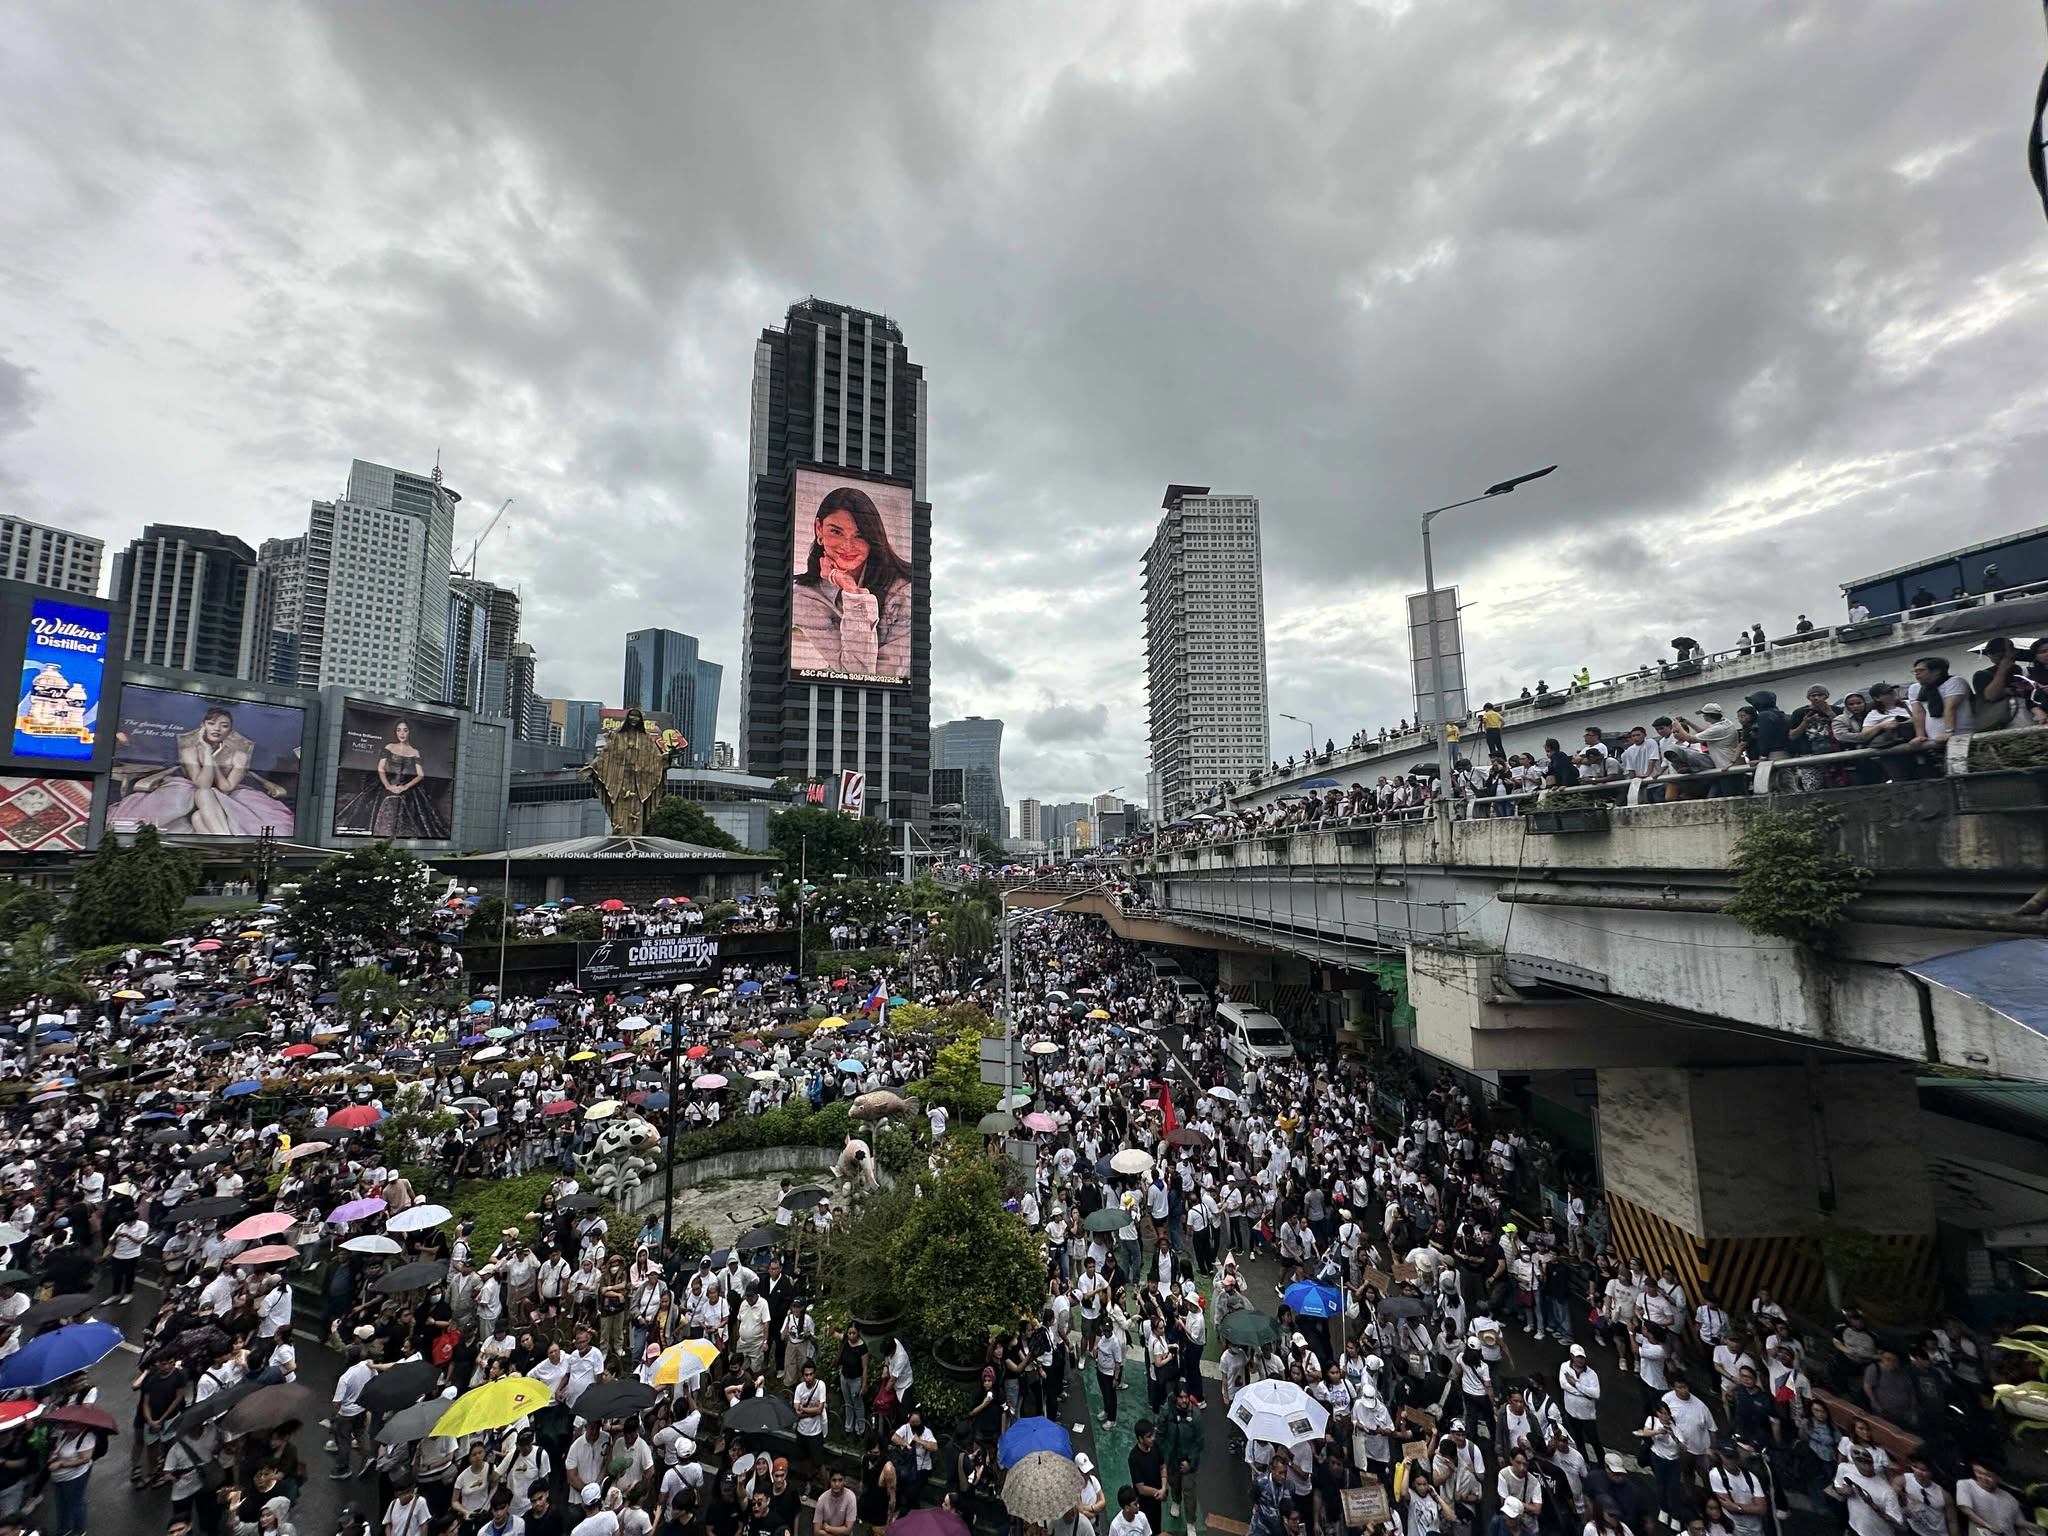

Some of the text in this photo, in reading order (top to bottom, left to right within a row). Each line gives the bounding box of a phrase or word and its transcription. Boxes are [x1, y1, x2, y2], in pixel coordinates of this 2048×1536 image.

[31, 617, 103, 641] Wilkins
[36, 634, 97, 653] Distilled
[800, 669, 816, 677] ASC
[638, 852, 662, 860] MARY,
[641, 936, 705, 947] WE STAND AGAINST
[628, 942, 719, 963] CORRUPTION
